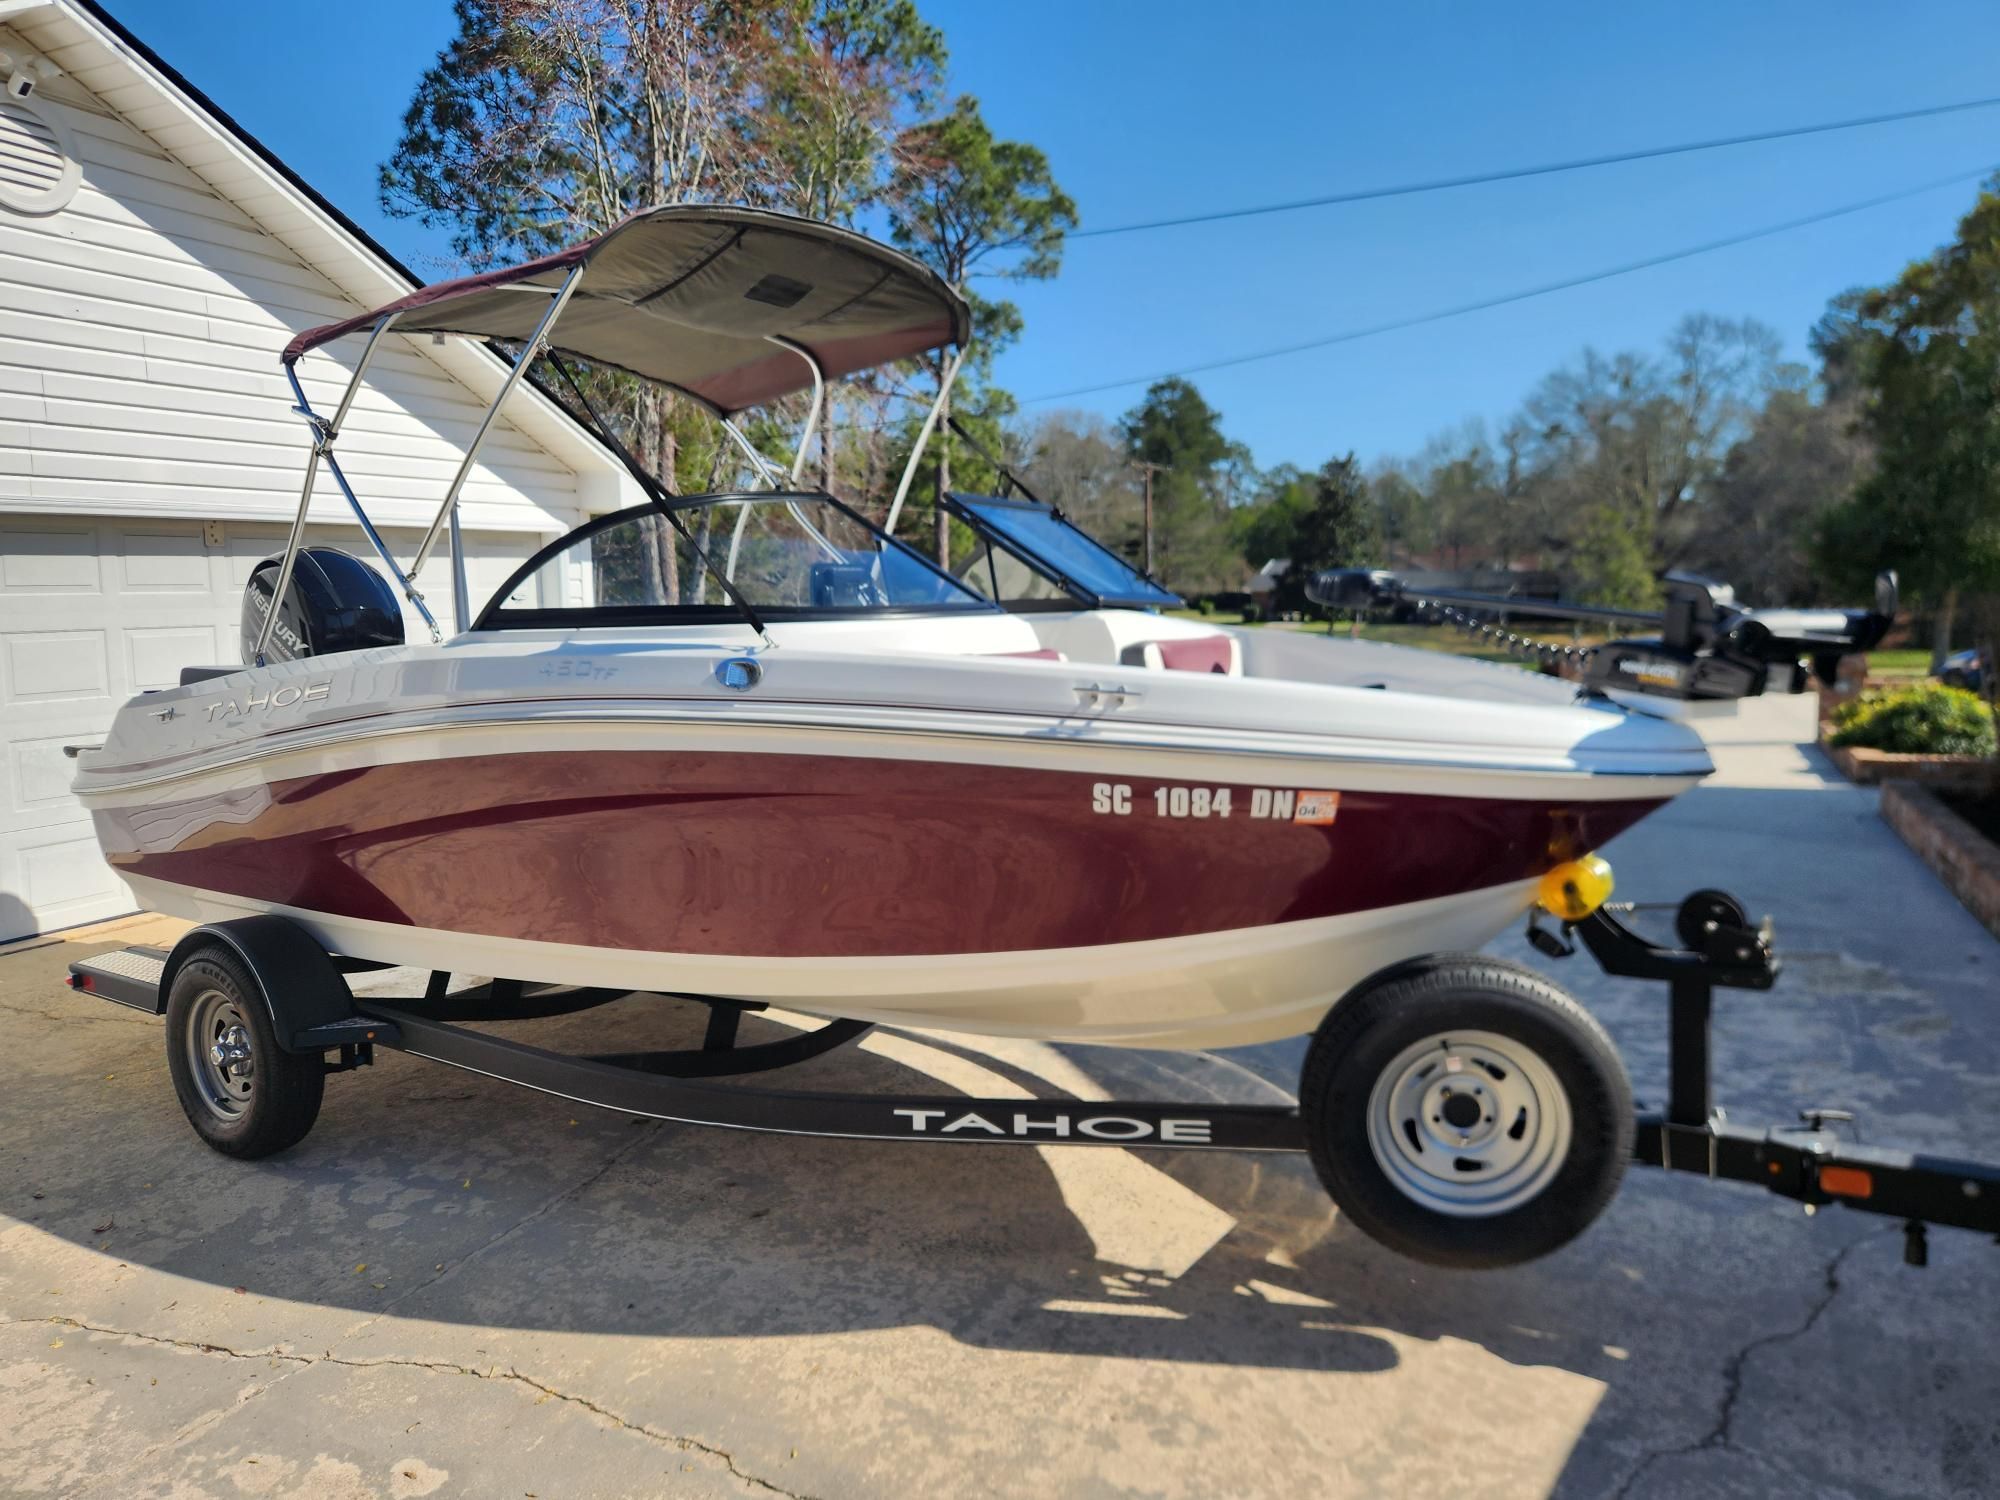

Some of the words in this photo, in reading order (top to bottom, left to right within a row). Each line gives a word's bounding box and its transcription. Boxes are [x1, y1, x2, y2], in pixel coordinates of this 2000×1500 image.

[248, 582, 310, 651] MERURY
[202, 678, 334, 723] TAHOE
[1092, 783, 1132, 815] SC
[1154, 787, 1232, 818] 1084
[1250, 788, 1294, 820] DN
[893, 1108, 1212, 1143] TAHOE
